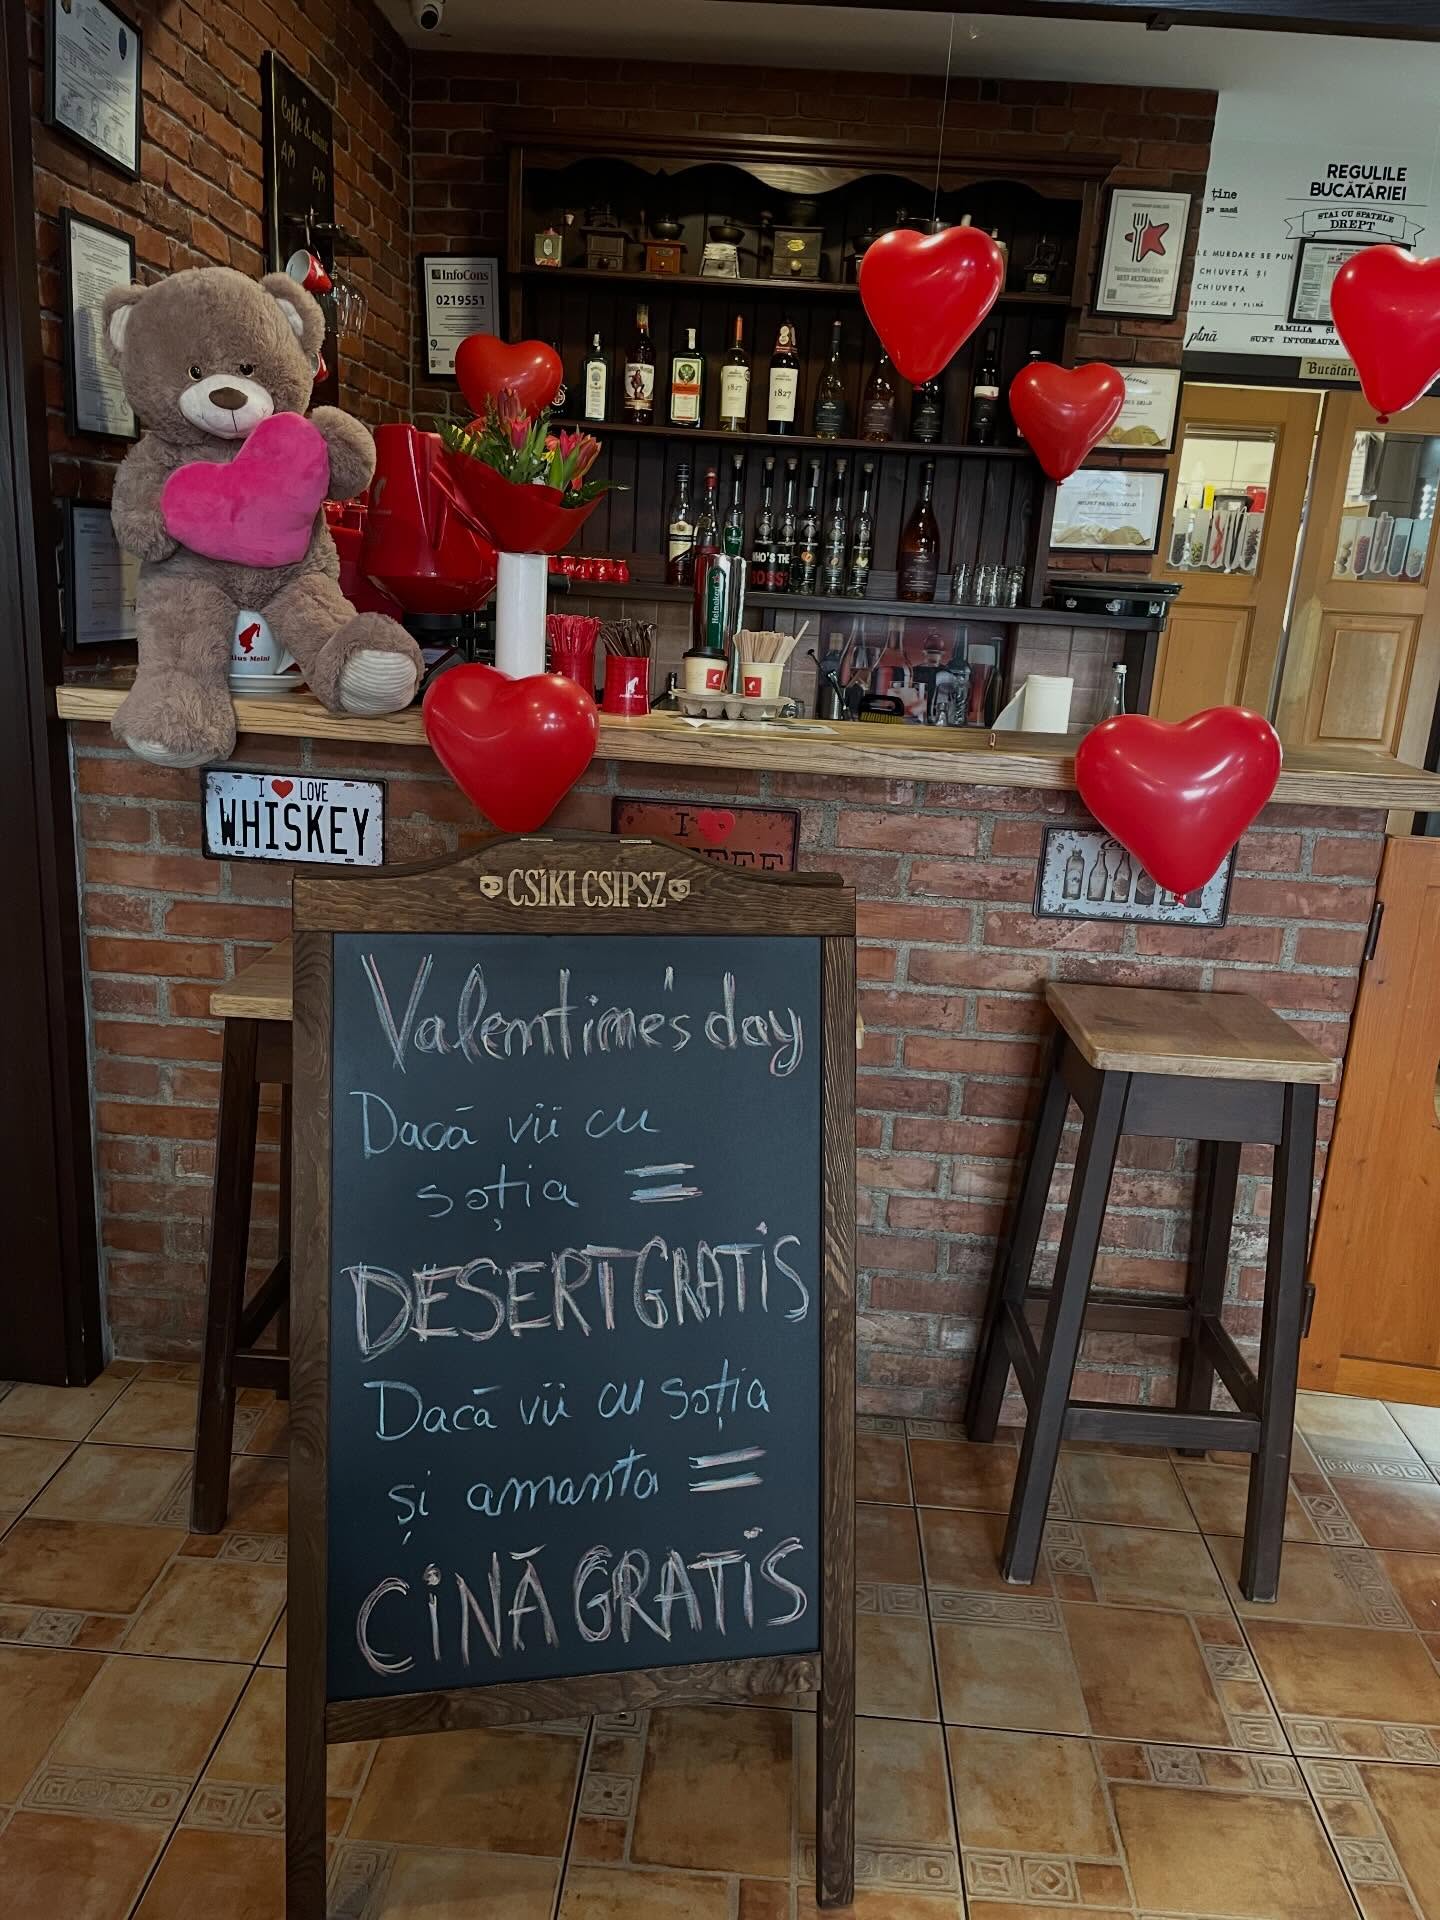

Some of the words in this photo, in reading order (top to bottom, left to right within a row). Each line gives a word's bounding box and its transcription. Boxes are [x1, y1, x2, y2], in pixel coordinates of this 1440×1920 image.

[1327, 163, 1407, 182] REGULILE
[1310, 181, 1407, 201] BUCĂTĂRIEI
[1317, 211, 1339, 220] STAI
[1341, 210, 1354, 218] CU
[1355, 210, 1395, 224] SPATELE
[1330, 219, 1376, 231] DREPT
[1212, 250, 1256, 259] MURDARE
[1260, 252, 1271, 260] SE
[1275, 253, 1294, 261] PUN
[442, 269, 489, 281] InfoCons
[1199, 267, 1249, 277] CHIUVETĂ
[1196, 283, 1246, 293] CHIUVETA
[436, 294, 486, 306] 0219551
[1274, 324, 1312, 333] FAMILIA
[1250, 335, 1275, 343] SUNT
[1306, 361, 1359, 377] Bucătări
[727, 383, 743, 392] 1827
[773, 388, 792, 400] 1827
[776, 553, 790, 564] THE
[711, 585, 721, 624] Heineken
[231, 654, 247, 662] lius
[258, 778, 265, 798] I
[299, 781, 329, 803] LOVE
[219, 797, 370, 857] WHISKEY
[674, 812, 690, 837] I
[581, 870, 667, 908] CSIPSZ
[705, 970, 804, 1077] day
[349, 1090, 479, 1159] Dacă
[584, 1103, 662, 1139] cu
[340, 1243, 640, 1362] DESERT
[363, 1380, 501, 1441] Dacă
[599, 1378, 645, 1419] cu
[466, 1444, 660, 1517] amanta
